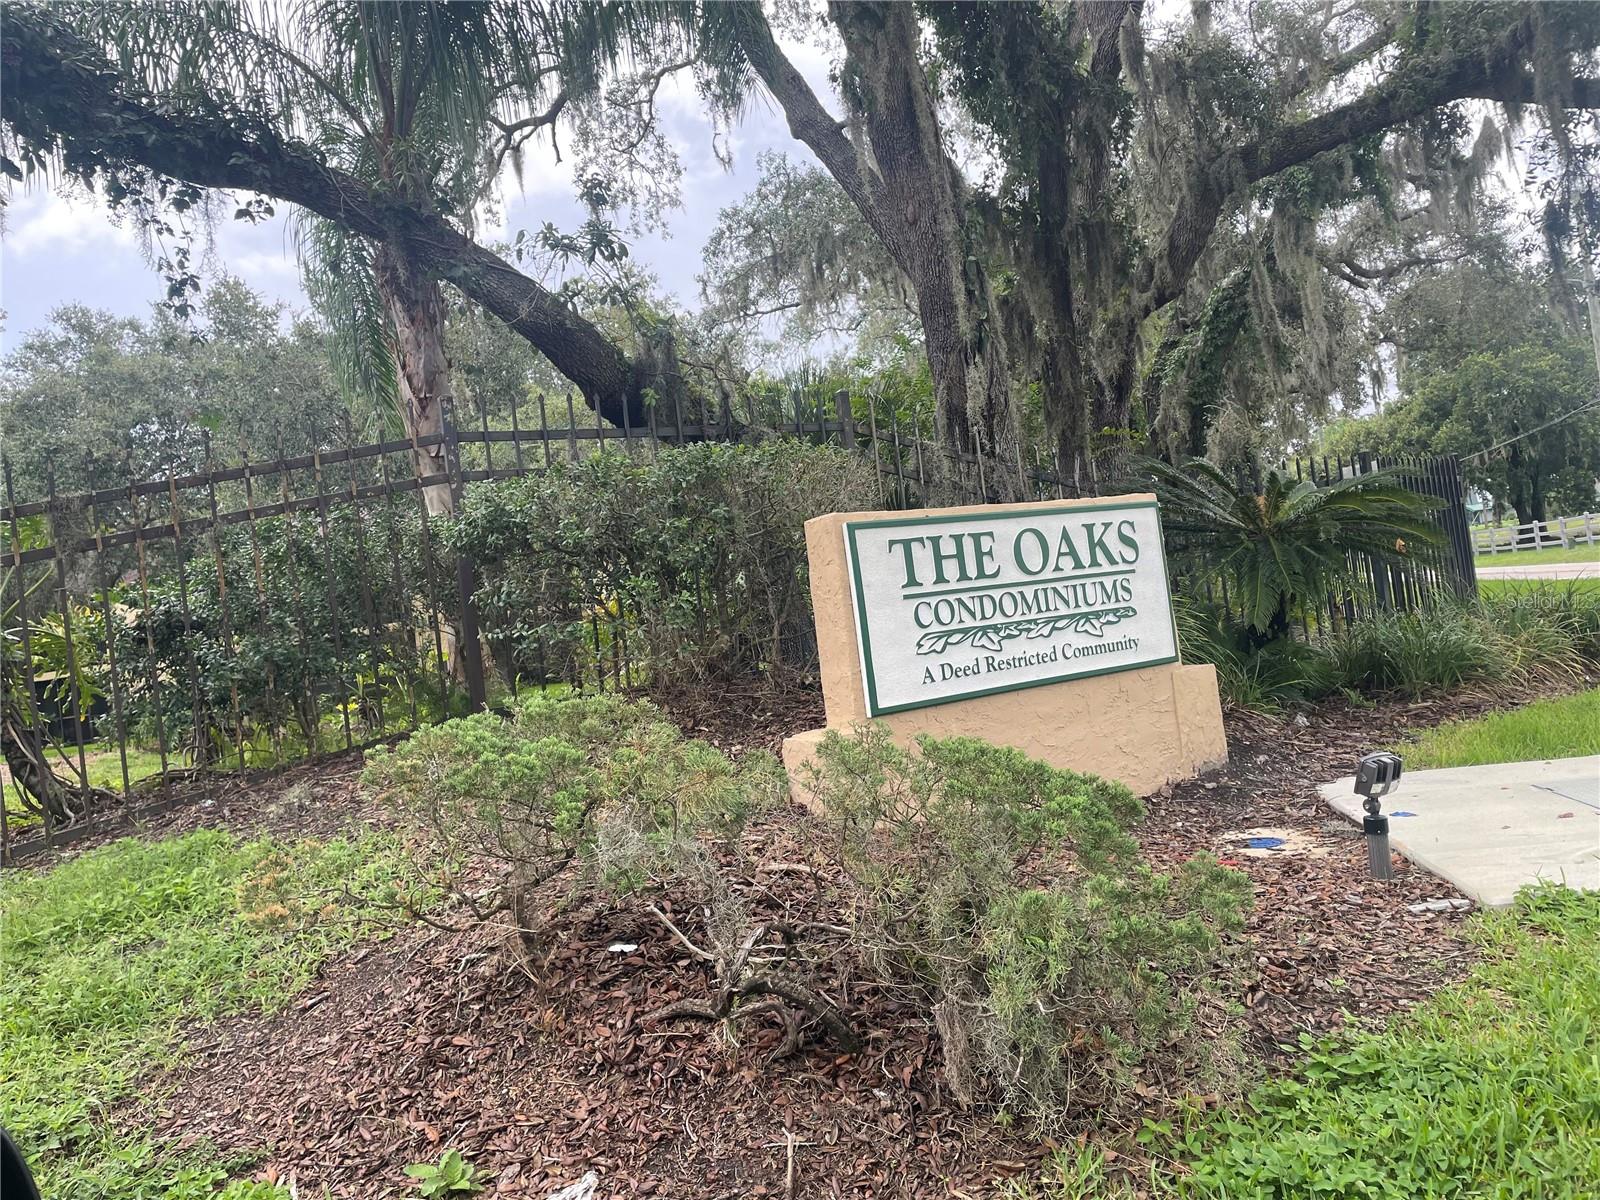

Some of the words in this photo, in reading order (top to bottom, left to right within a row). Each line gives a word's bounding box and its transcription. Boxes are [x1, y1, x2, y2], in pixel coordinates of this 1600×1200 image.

[888, 530, 1001, 589] THE
[1013, 519, 1140, 576] OAKS
[913, 577, 1133, 629] CONDOMINIUMS
[921, 666, 936, 685] A
[940, 657, 981, 682] Deed
[985, 648, 1058, 674] Restricted
[1062, 636, 1140, 661] Community
